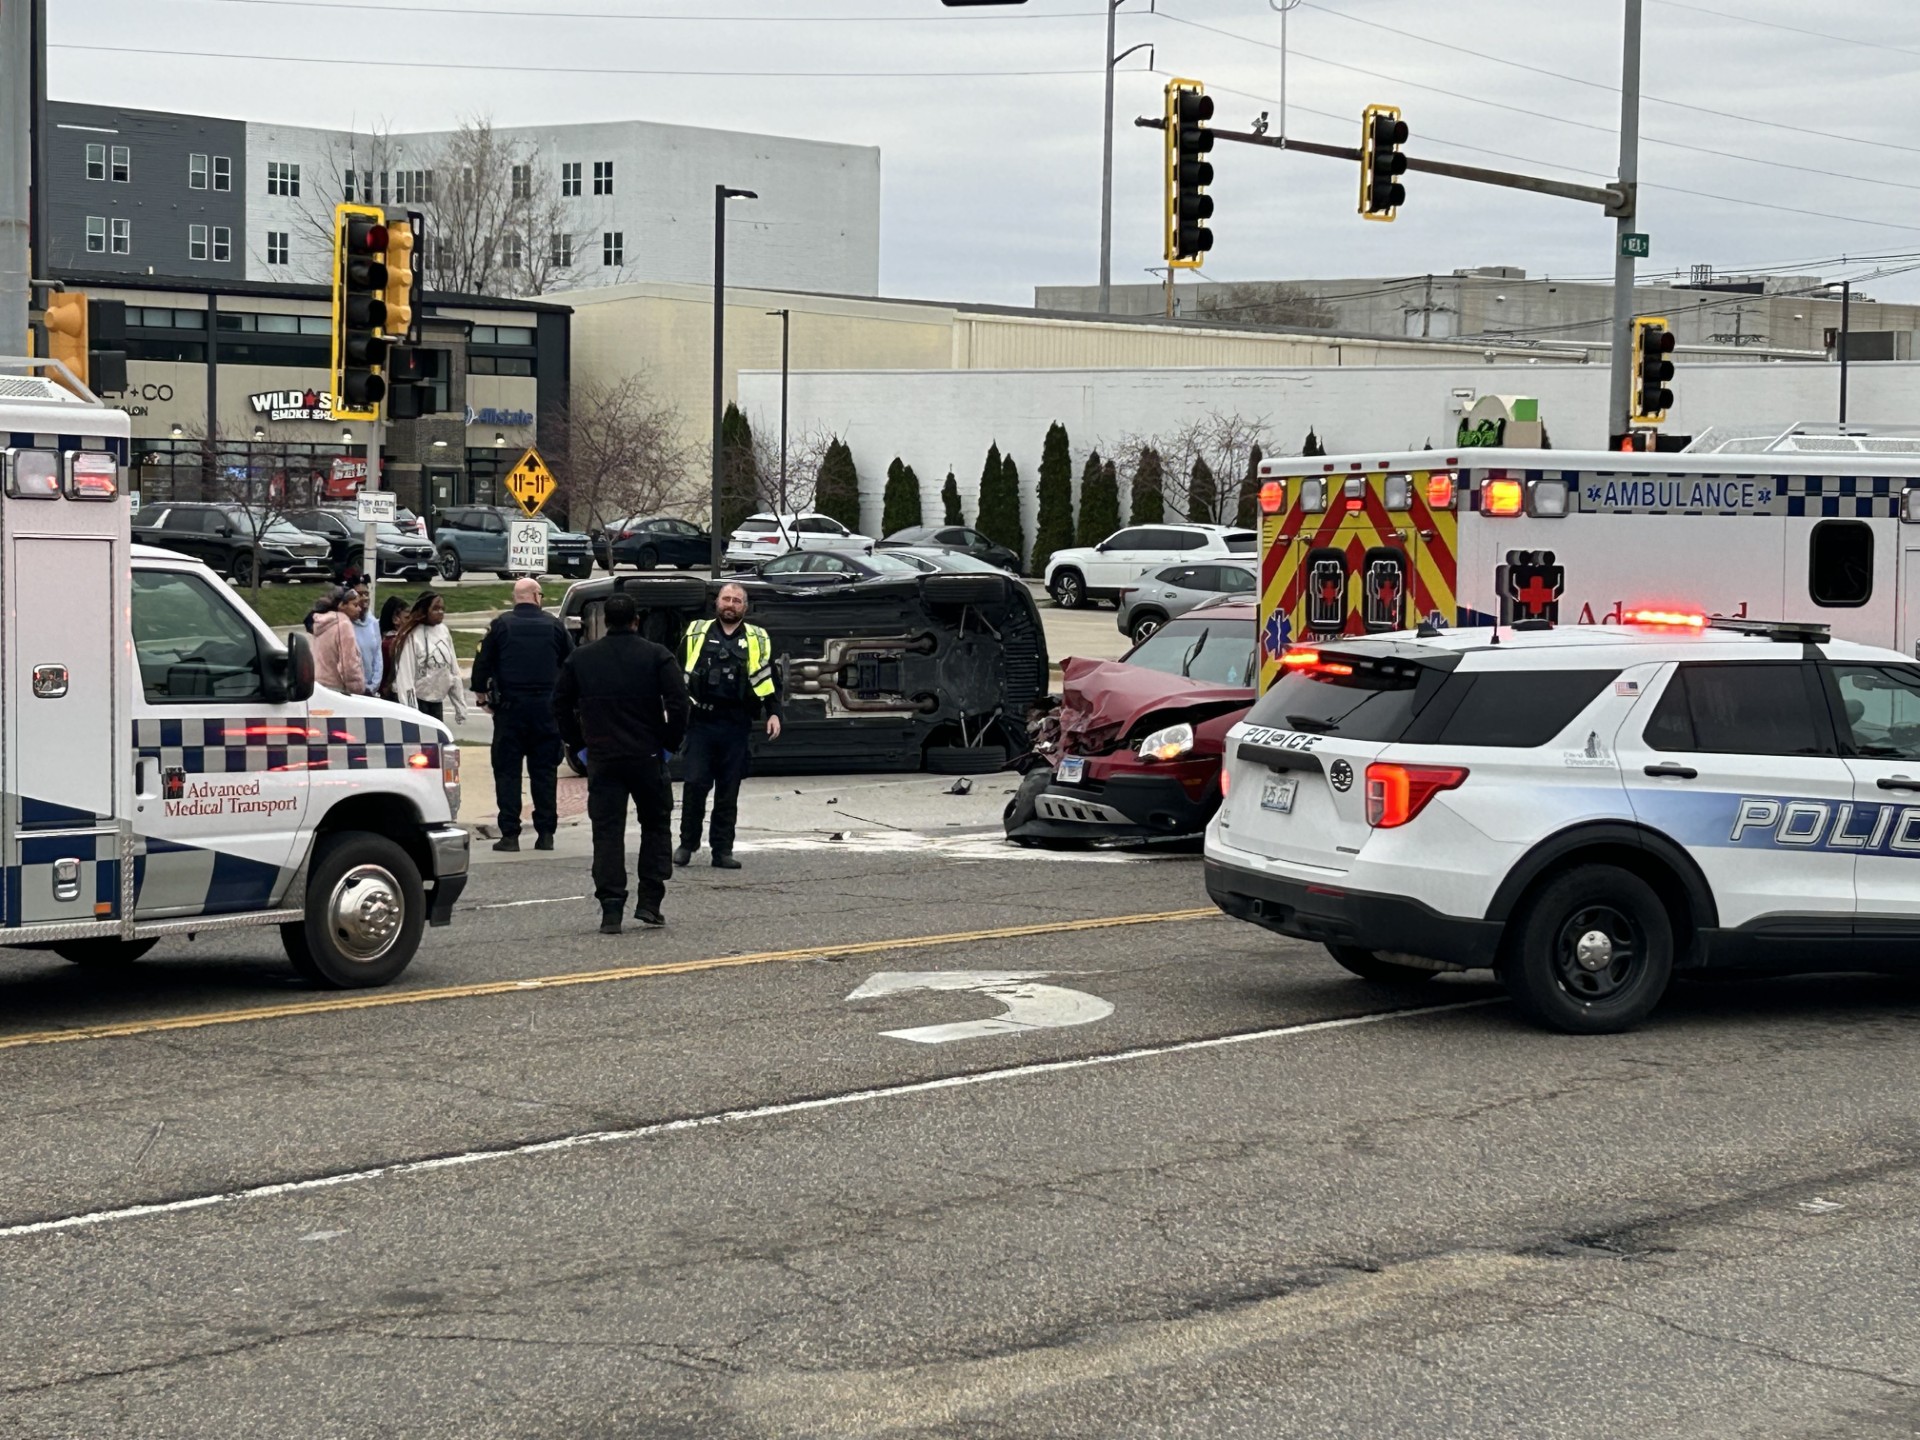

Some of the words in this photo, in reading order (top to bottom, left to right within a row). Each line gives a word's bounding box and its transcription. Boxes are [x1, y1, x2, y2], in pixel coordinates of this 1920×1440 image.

[251, 391, 304, 412] WILD
[271, 409, 310, 421] SMOKE
[1603, 481, 1754, 507] AMBULANCE
[1242, 727, 1322, 751] POLICE
[187, 779, 261, 798] Advanced
[164, 799, 223, 817] Medical
[228, 796, 298, 817] Transport
[1729, 798, 1920, 852] POLIC
